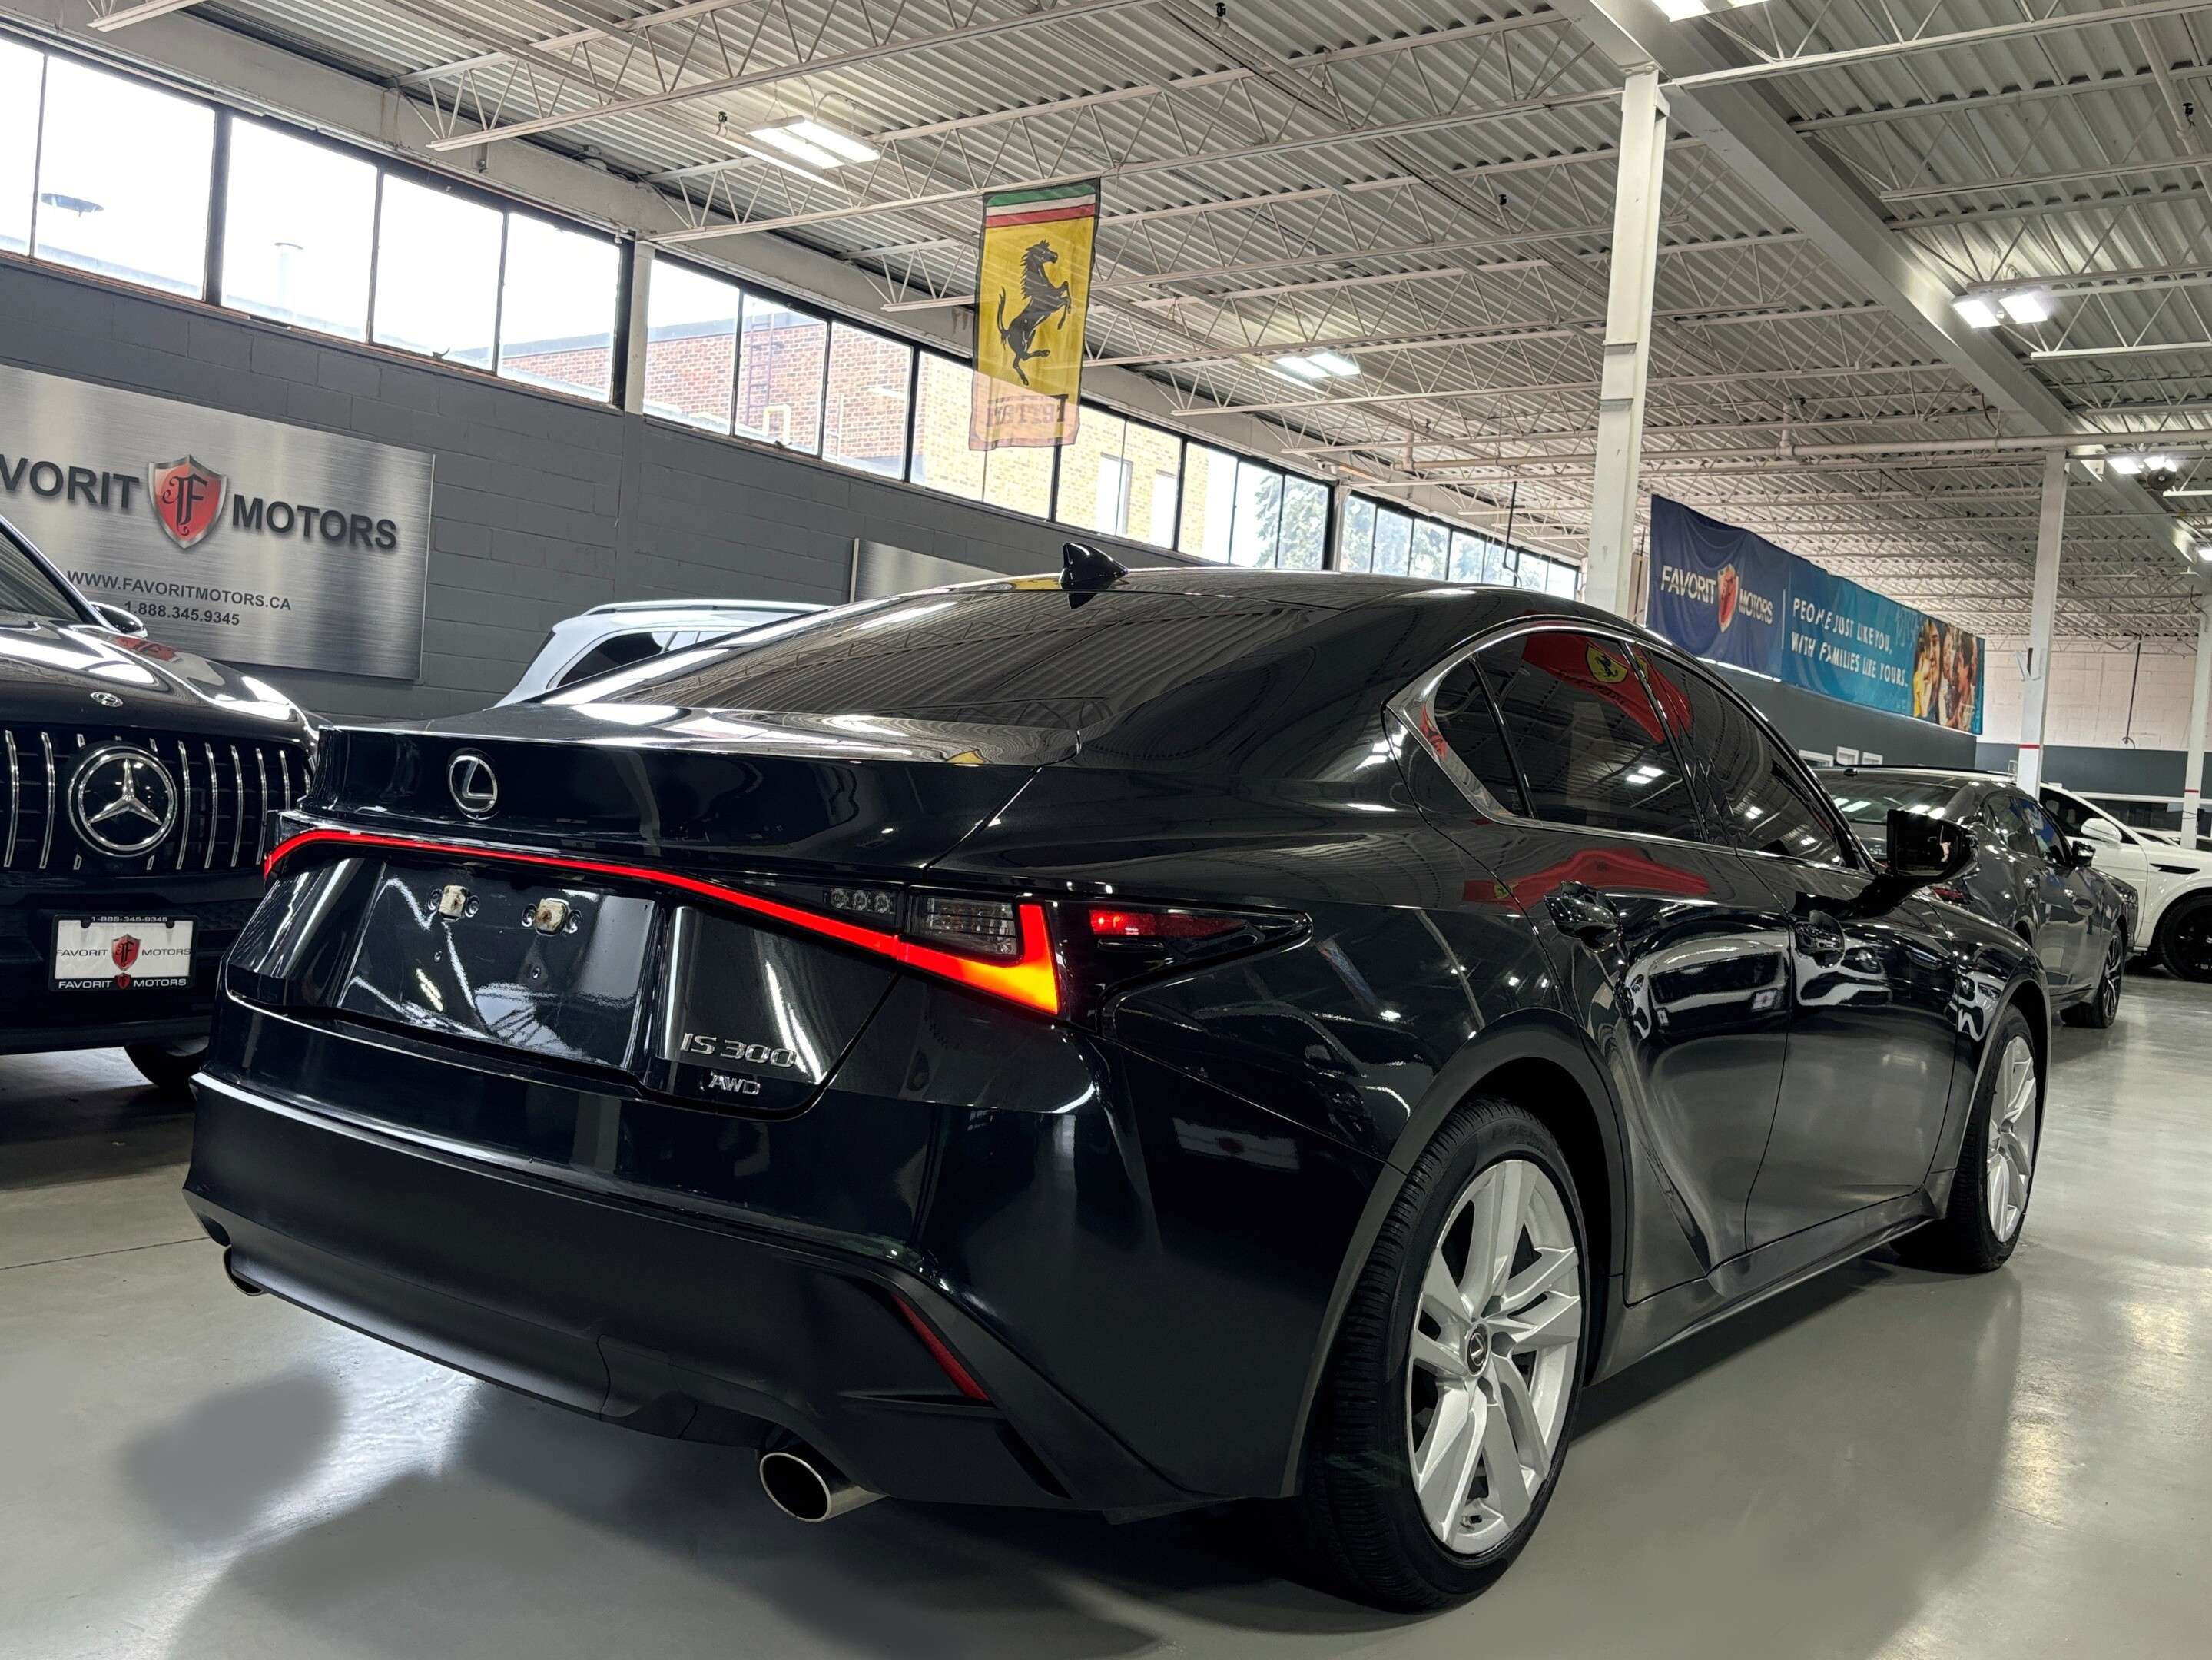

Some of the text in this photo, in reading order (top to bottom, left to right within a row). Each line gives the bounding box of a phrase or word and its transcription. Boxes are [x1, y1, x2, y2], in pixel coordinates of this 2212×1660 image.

[233, 493, 398, 550] MOTORS
[67, 570, 292, 612] WWW.FAVORITMOTORS.CA
[1661, 565, 1773, 625] FAVORIT MOTORS
[124, 600, 240, 626] 1.888.345.9345
[1832, 614, 1855, 639] JUST
[1857, 622, 1873, 646] LIKE
[1791, 631, 1816, 658] WITH
[1862, 657, 1877, 679] LIKE
[1879, 663, 1909, 688] YOURS.
[141, 948, 191, 957] MOTORS
[58, 978, 187, 989] FAVORIT MOTORS
[679, 1032, 798, 1069] IS 300
[708, 1073, 761, 1095] AWD
